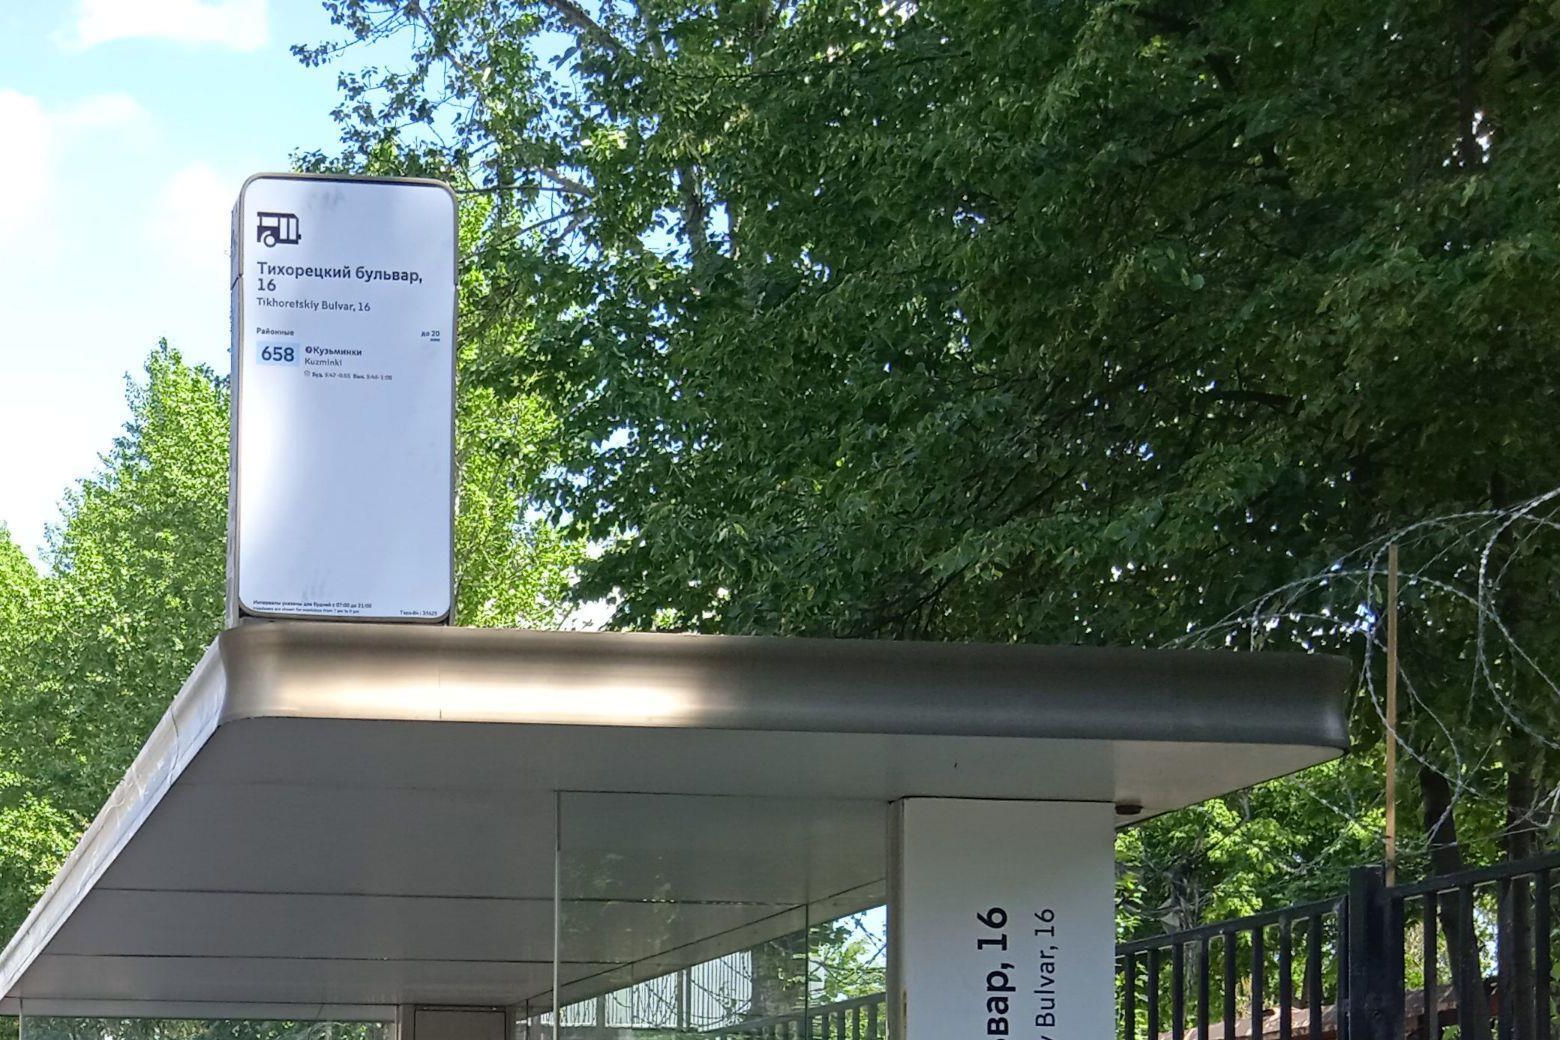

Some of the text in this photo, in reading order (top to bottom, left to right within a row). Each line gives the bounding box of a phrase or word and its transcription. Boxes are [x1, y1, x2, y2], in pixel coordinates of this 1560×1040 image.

[256, 261, 423, 285] Тихорецкий бульвар,
[257, 277, 277, 292] 16
[256, 297, 371, 312] Tikhoretskiy Bulvar, 16
[256, 327, 295, 336] Районные
[430, 330, 440, 338] 20
[261, 346, 295, 362] 658
[313, 346, 362, 357] Кузьминки
[304, 357, 342, 367] Kuzminki
[977, 906, 1008, 951] 16
[1034, 908, 1055, 937] 16
[1035, 946, 1059, 1027] Bulvar,
